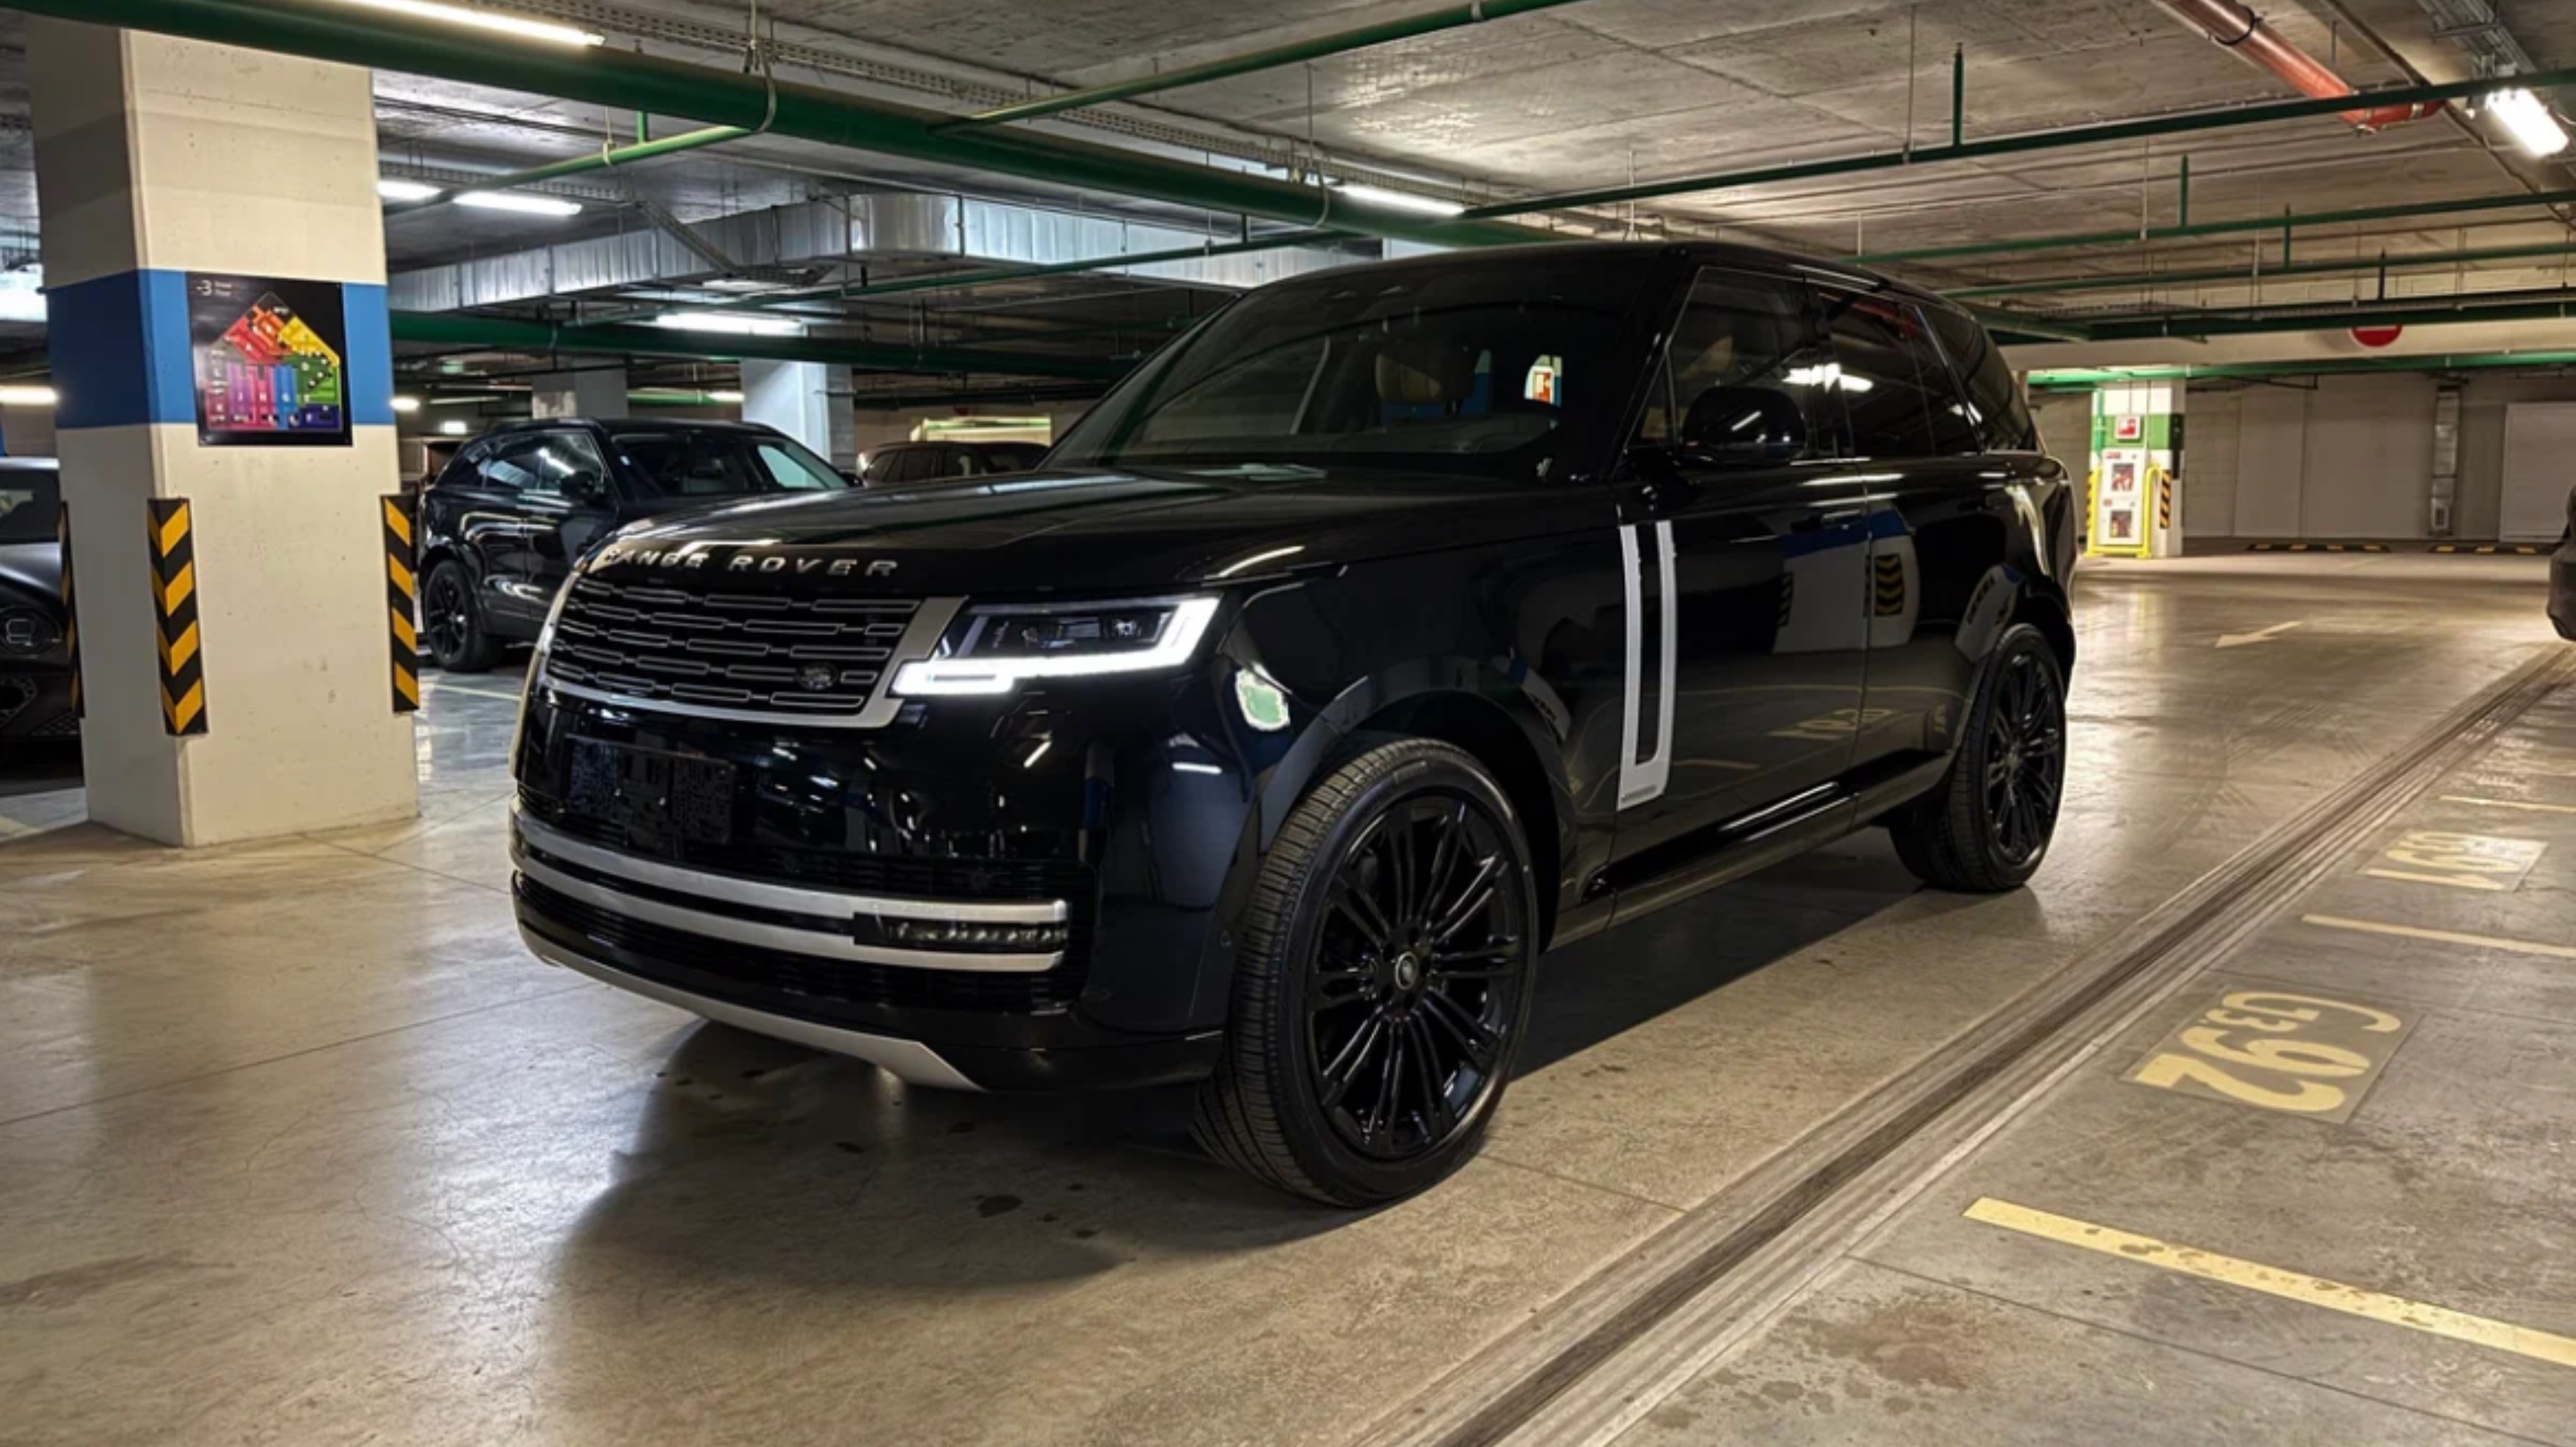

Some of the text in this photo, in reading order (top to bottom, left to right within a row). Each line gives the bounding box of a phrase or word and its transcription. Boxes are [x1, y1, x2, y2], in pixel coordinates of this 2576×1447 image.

[195, 280, 212, 296] -3
[602, 547, 899, 577] RANGE ROVER
